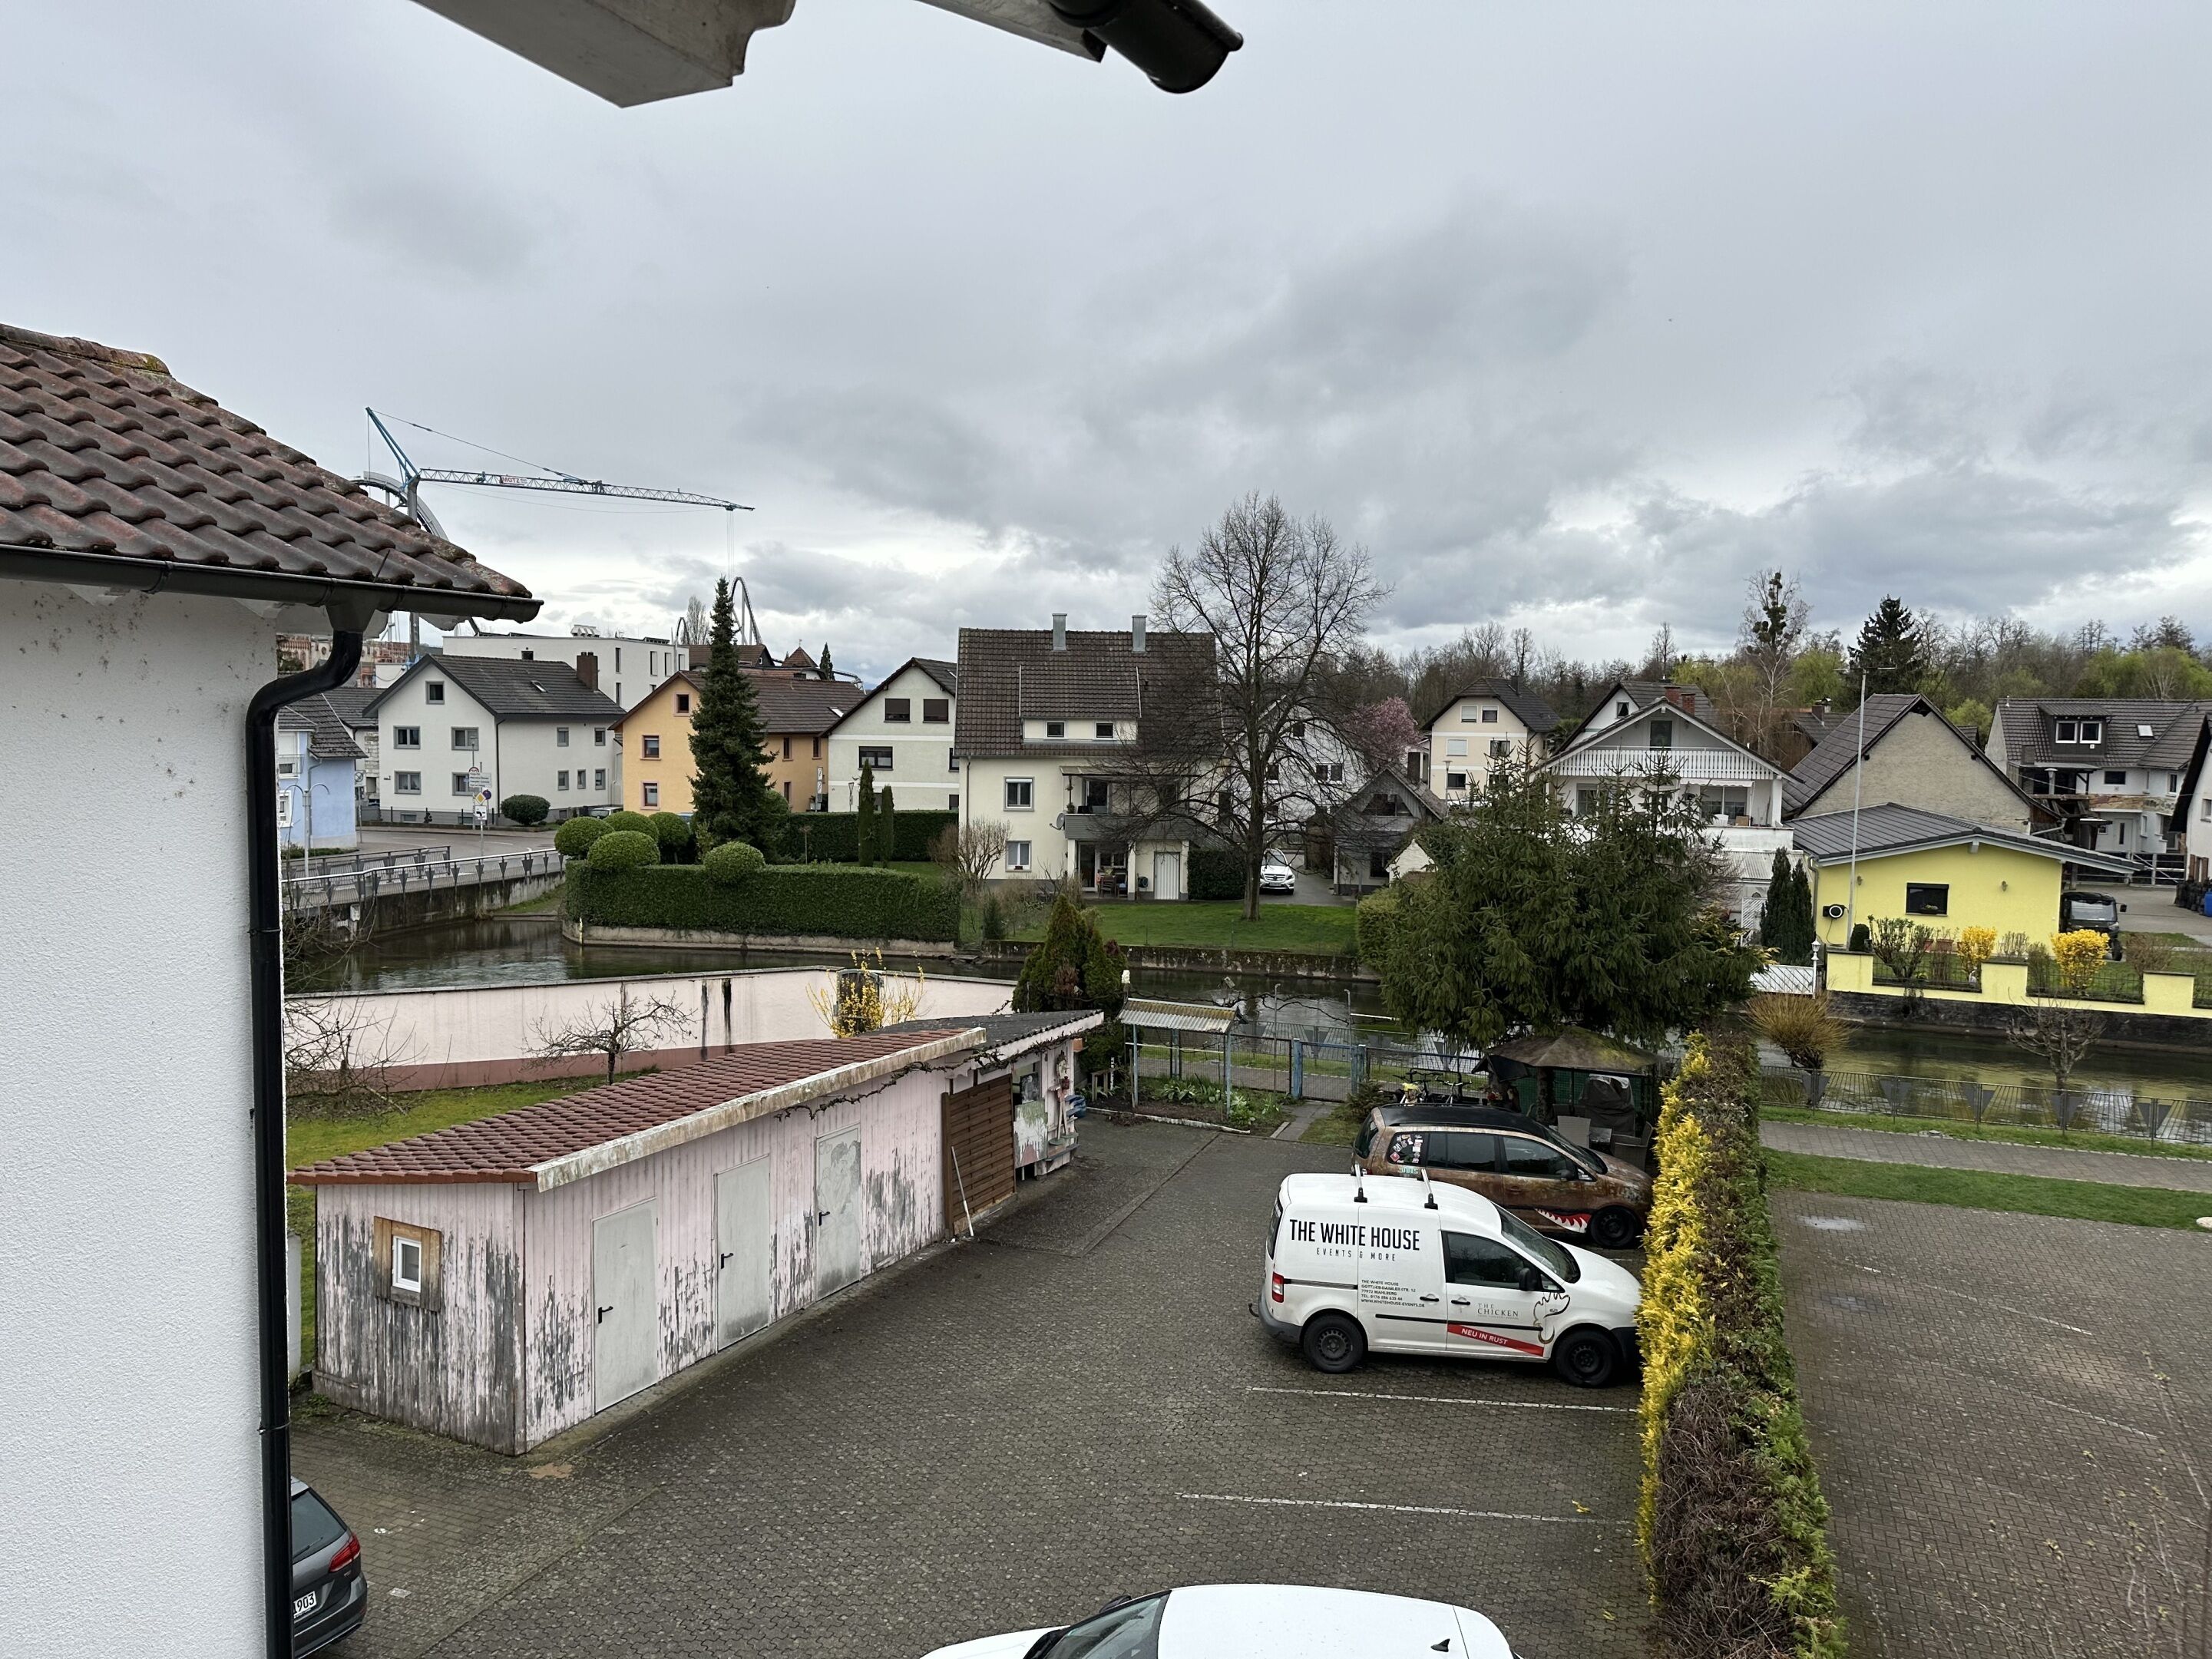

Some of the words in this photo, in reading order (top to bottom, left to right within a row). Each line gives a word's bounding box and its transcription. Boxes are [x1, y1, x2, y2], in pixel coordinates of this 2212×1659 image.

[1290, 1219, 1316, 1242] THE
[1321, 1222, 1366, 1246] WHITE
[1371, 1227, 1420, 1251] HOUSE
[1317, 1248, 1352, 1257] EVENTS
[1359, 1251, 1364, 1259] &
[1371, 1252, 1396, 1261] MORE
[1477, 1307, 1519, 1317] CHICKEN
[1461, 1328, 1478, 1337] NEU
[1489, 1335, 1508, 1345] RUST
